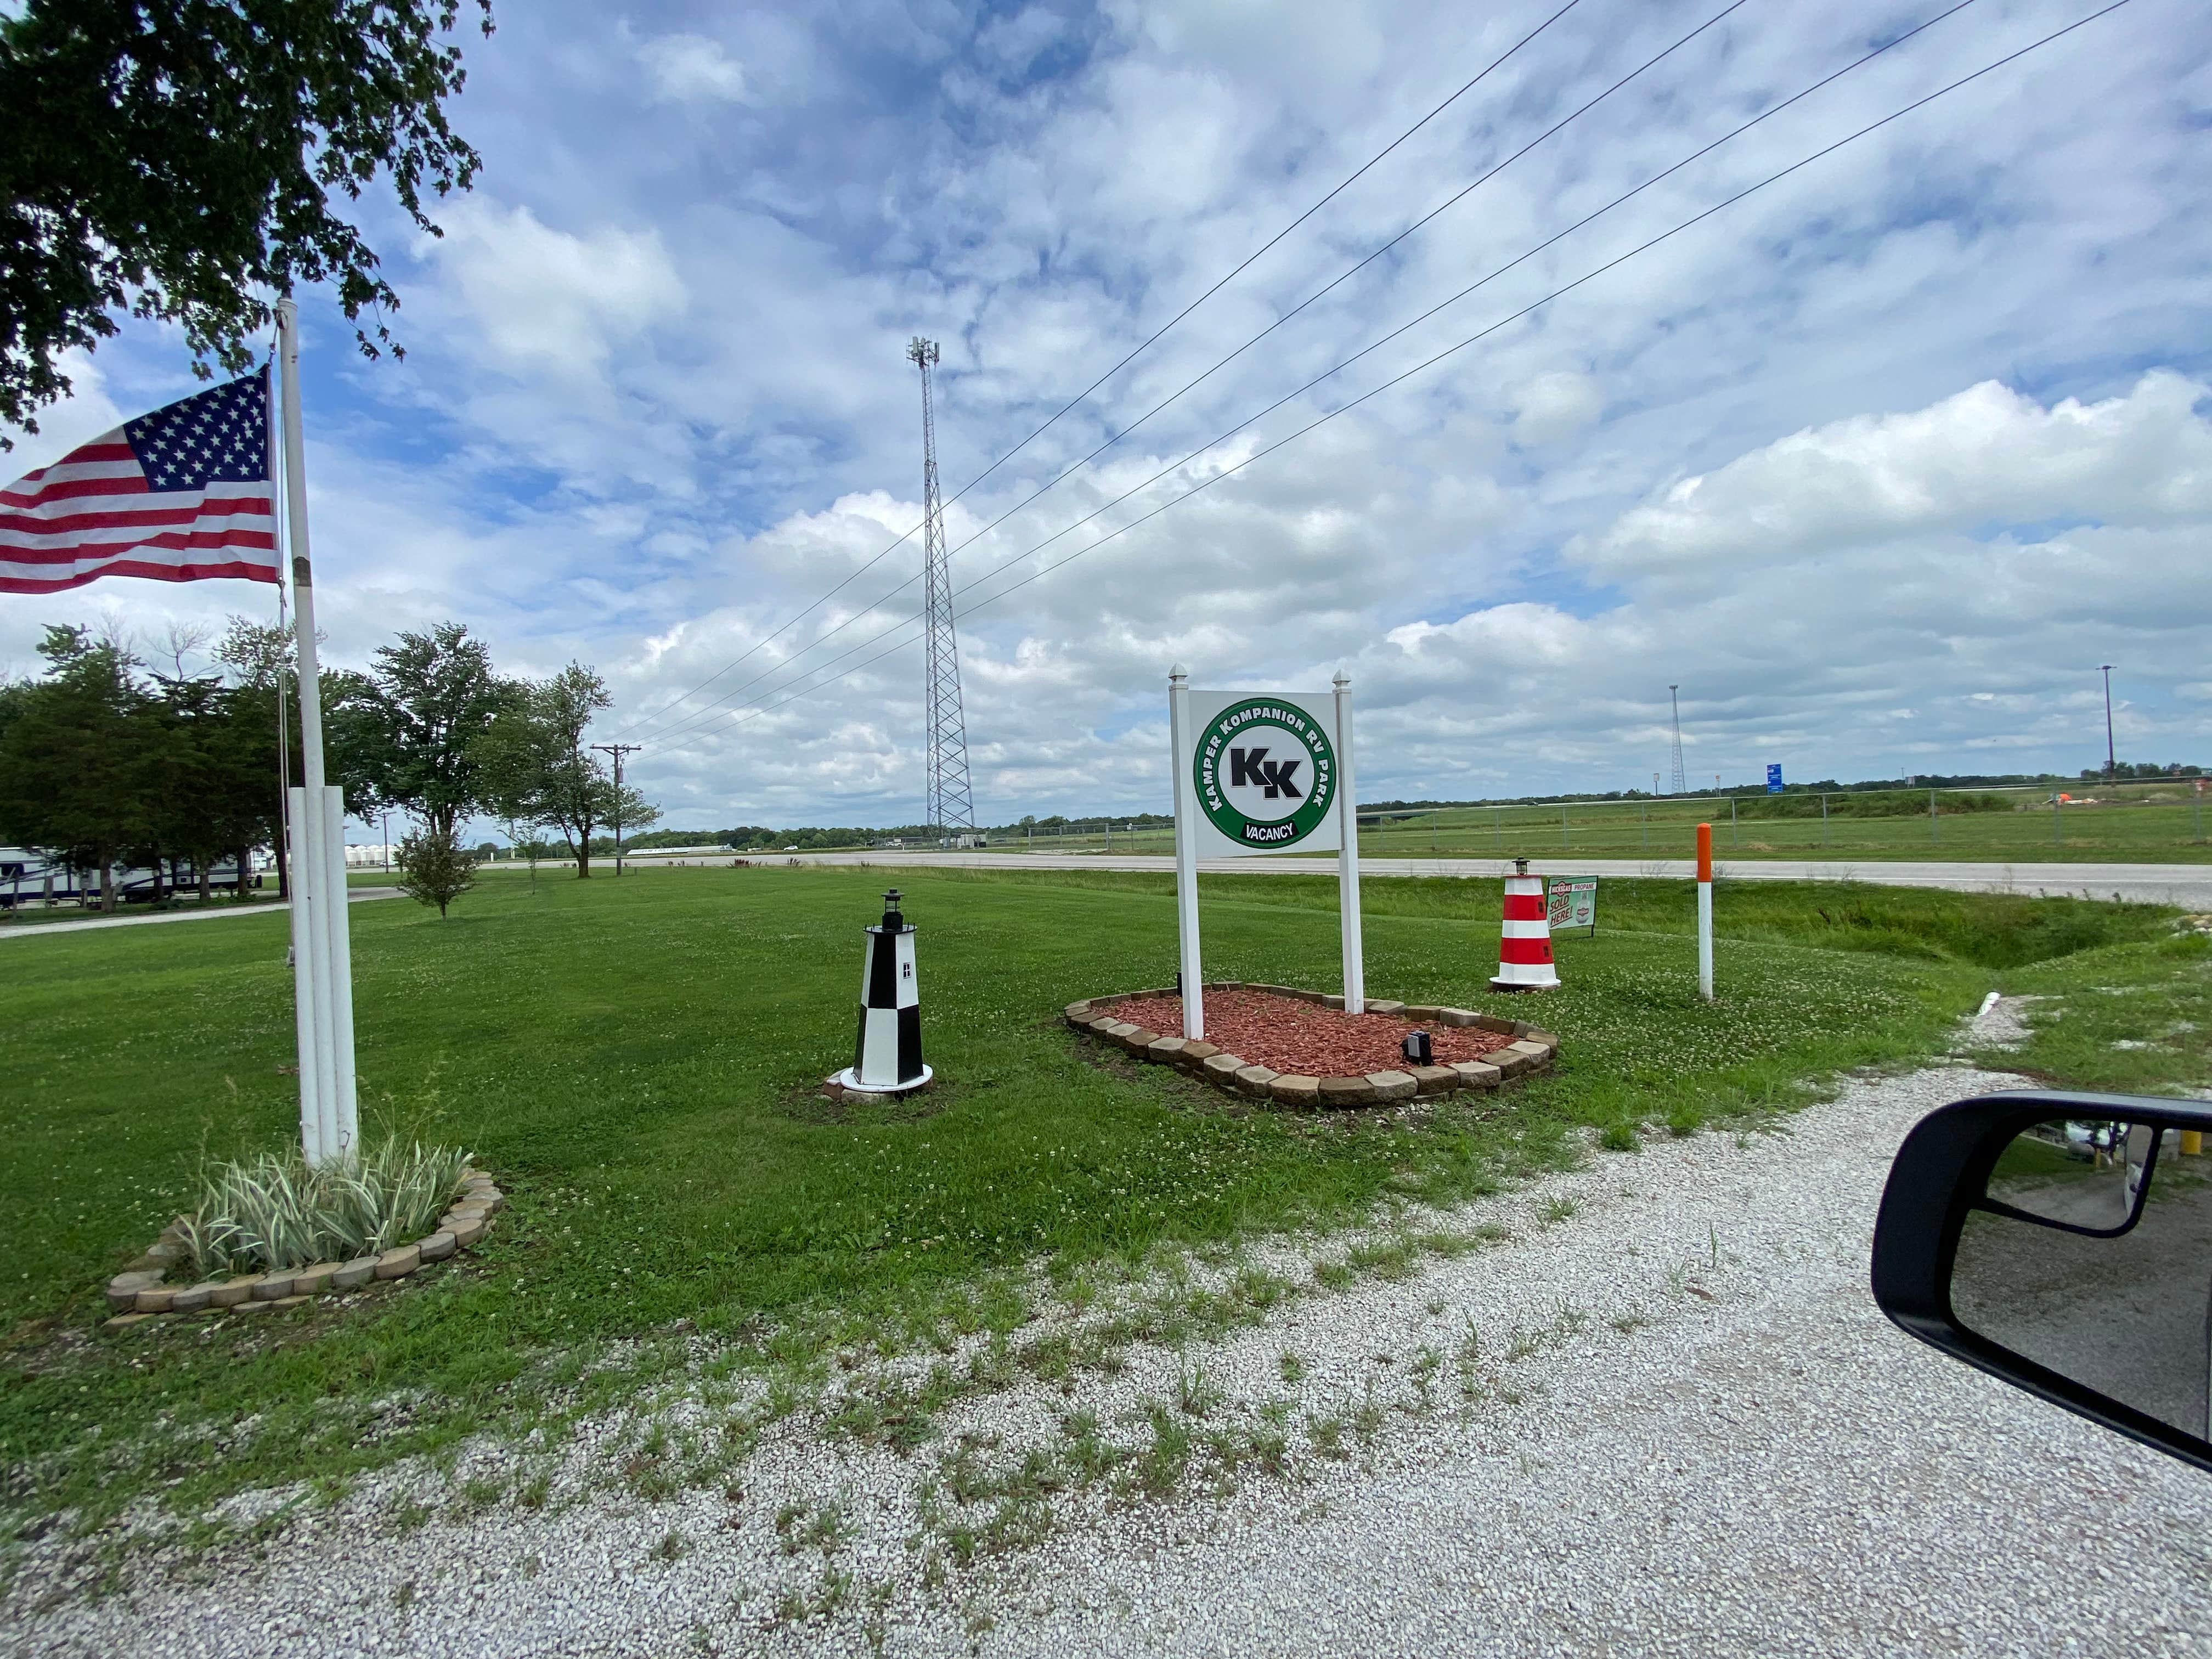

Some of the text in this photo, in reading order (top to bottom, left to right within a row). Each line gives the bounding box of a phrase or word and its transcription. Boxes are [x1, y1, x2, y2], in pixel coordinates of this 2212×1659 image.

[1203, 707, 1329, 812] KAMPER KOMPANION RV PARK
[1246, 822, 1294, 841] VACANCY
[1550, 895, 1570, 912] SOLD
[1550, 905, 1573, 926] HERE!
